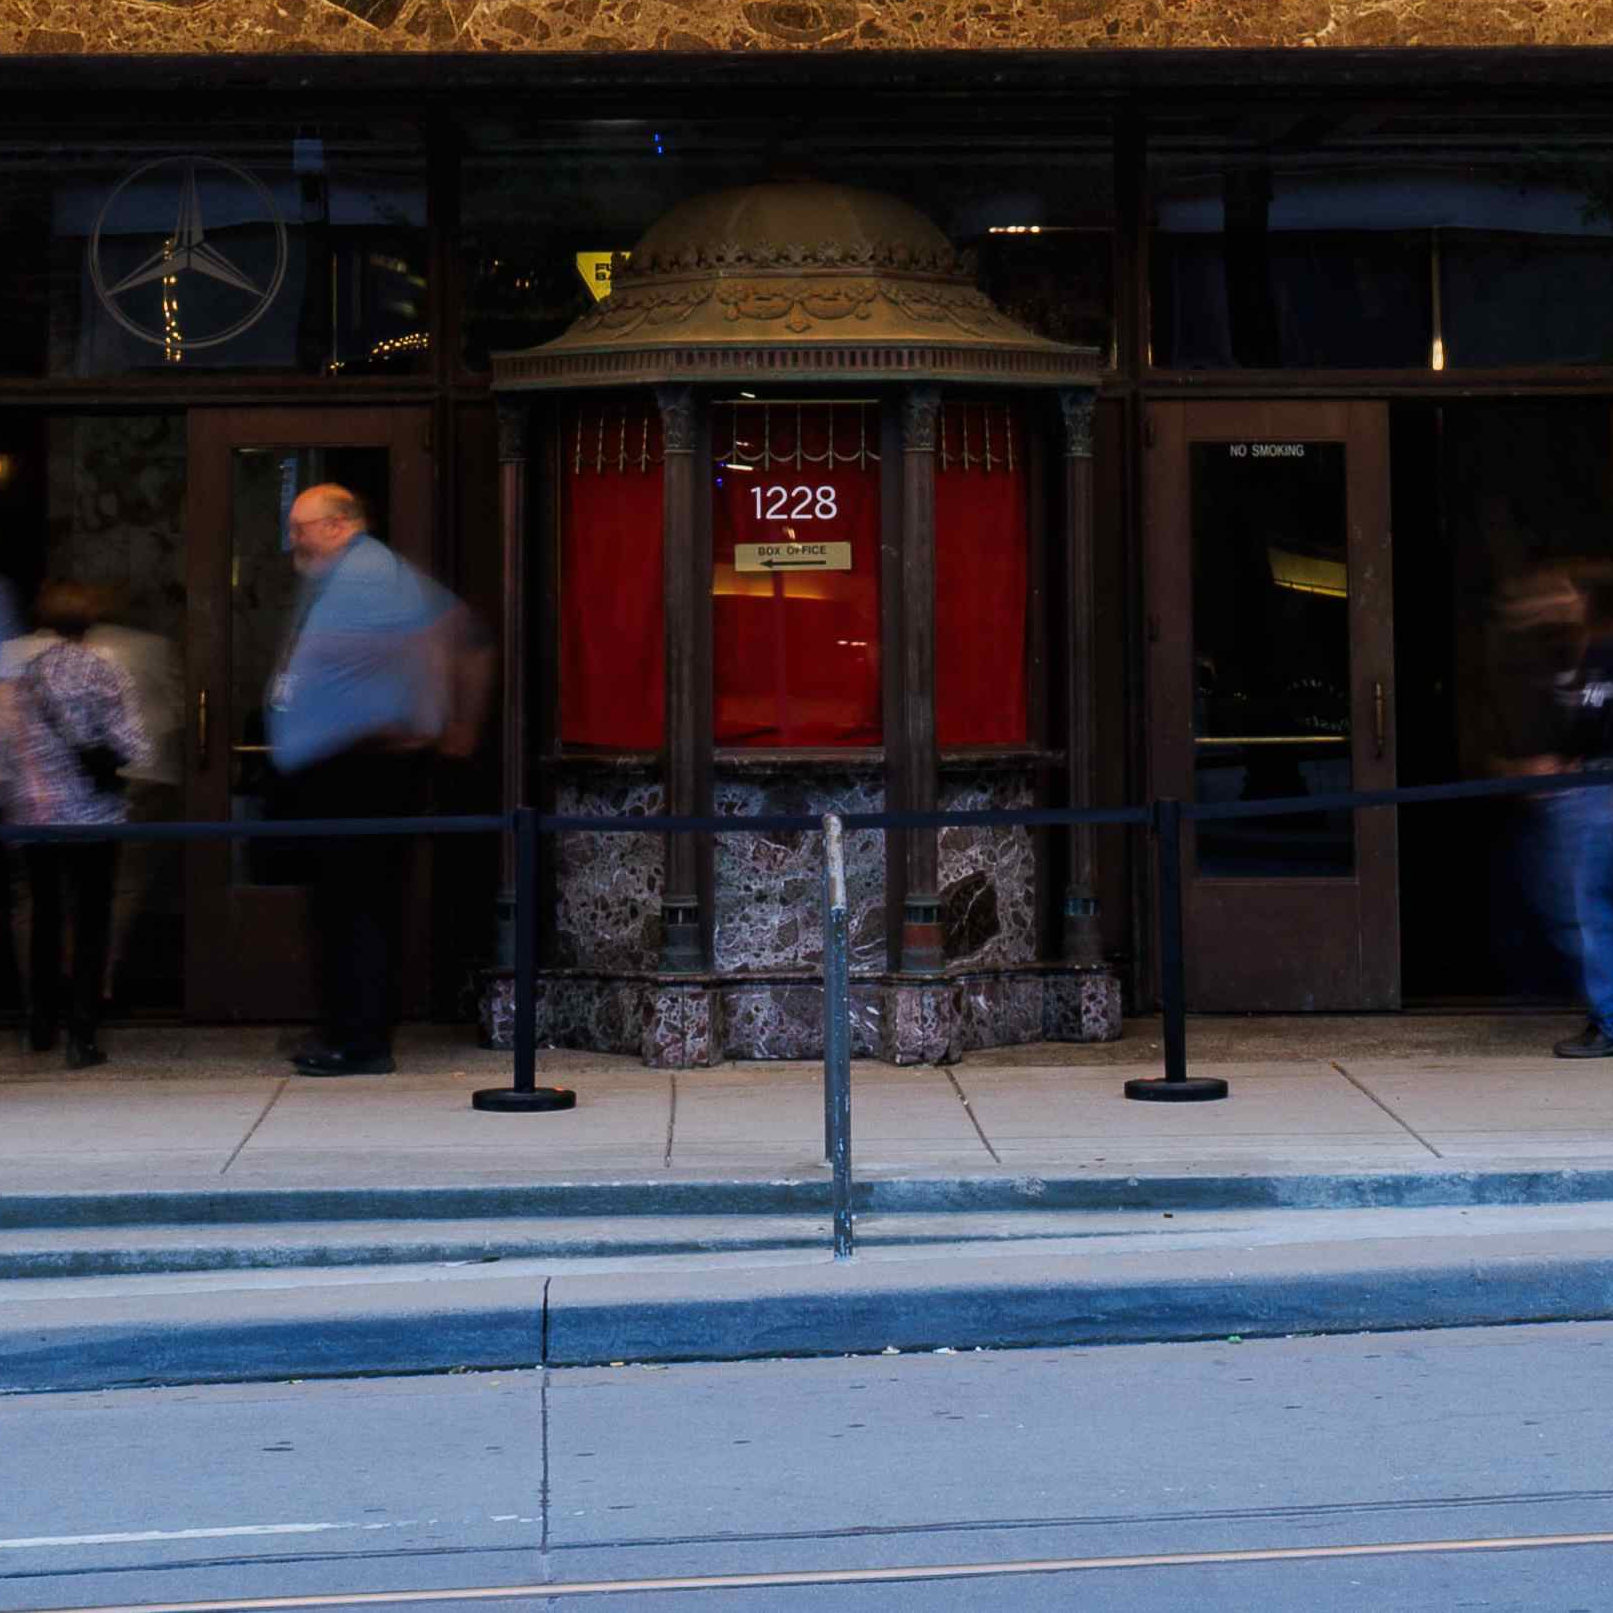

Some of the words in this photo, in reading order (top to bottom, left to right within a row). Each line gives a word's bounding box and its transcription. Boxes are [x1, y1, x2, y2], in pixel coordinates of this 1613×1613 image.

[1229, 443, 1247, 458] NO
[1251, 443, 1305, 458] SMOKING
[750, 485, 838, 520] 1228
[758, 546, 780, 556] BOX
[787, 545, 827, 556] OFFICE
